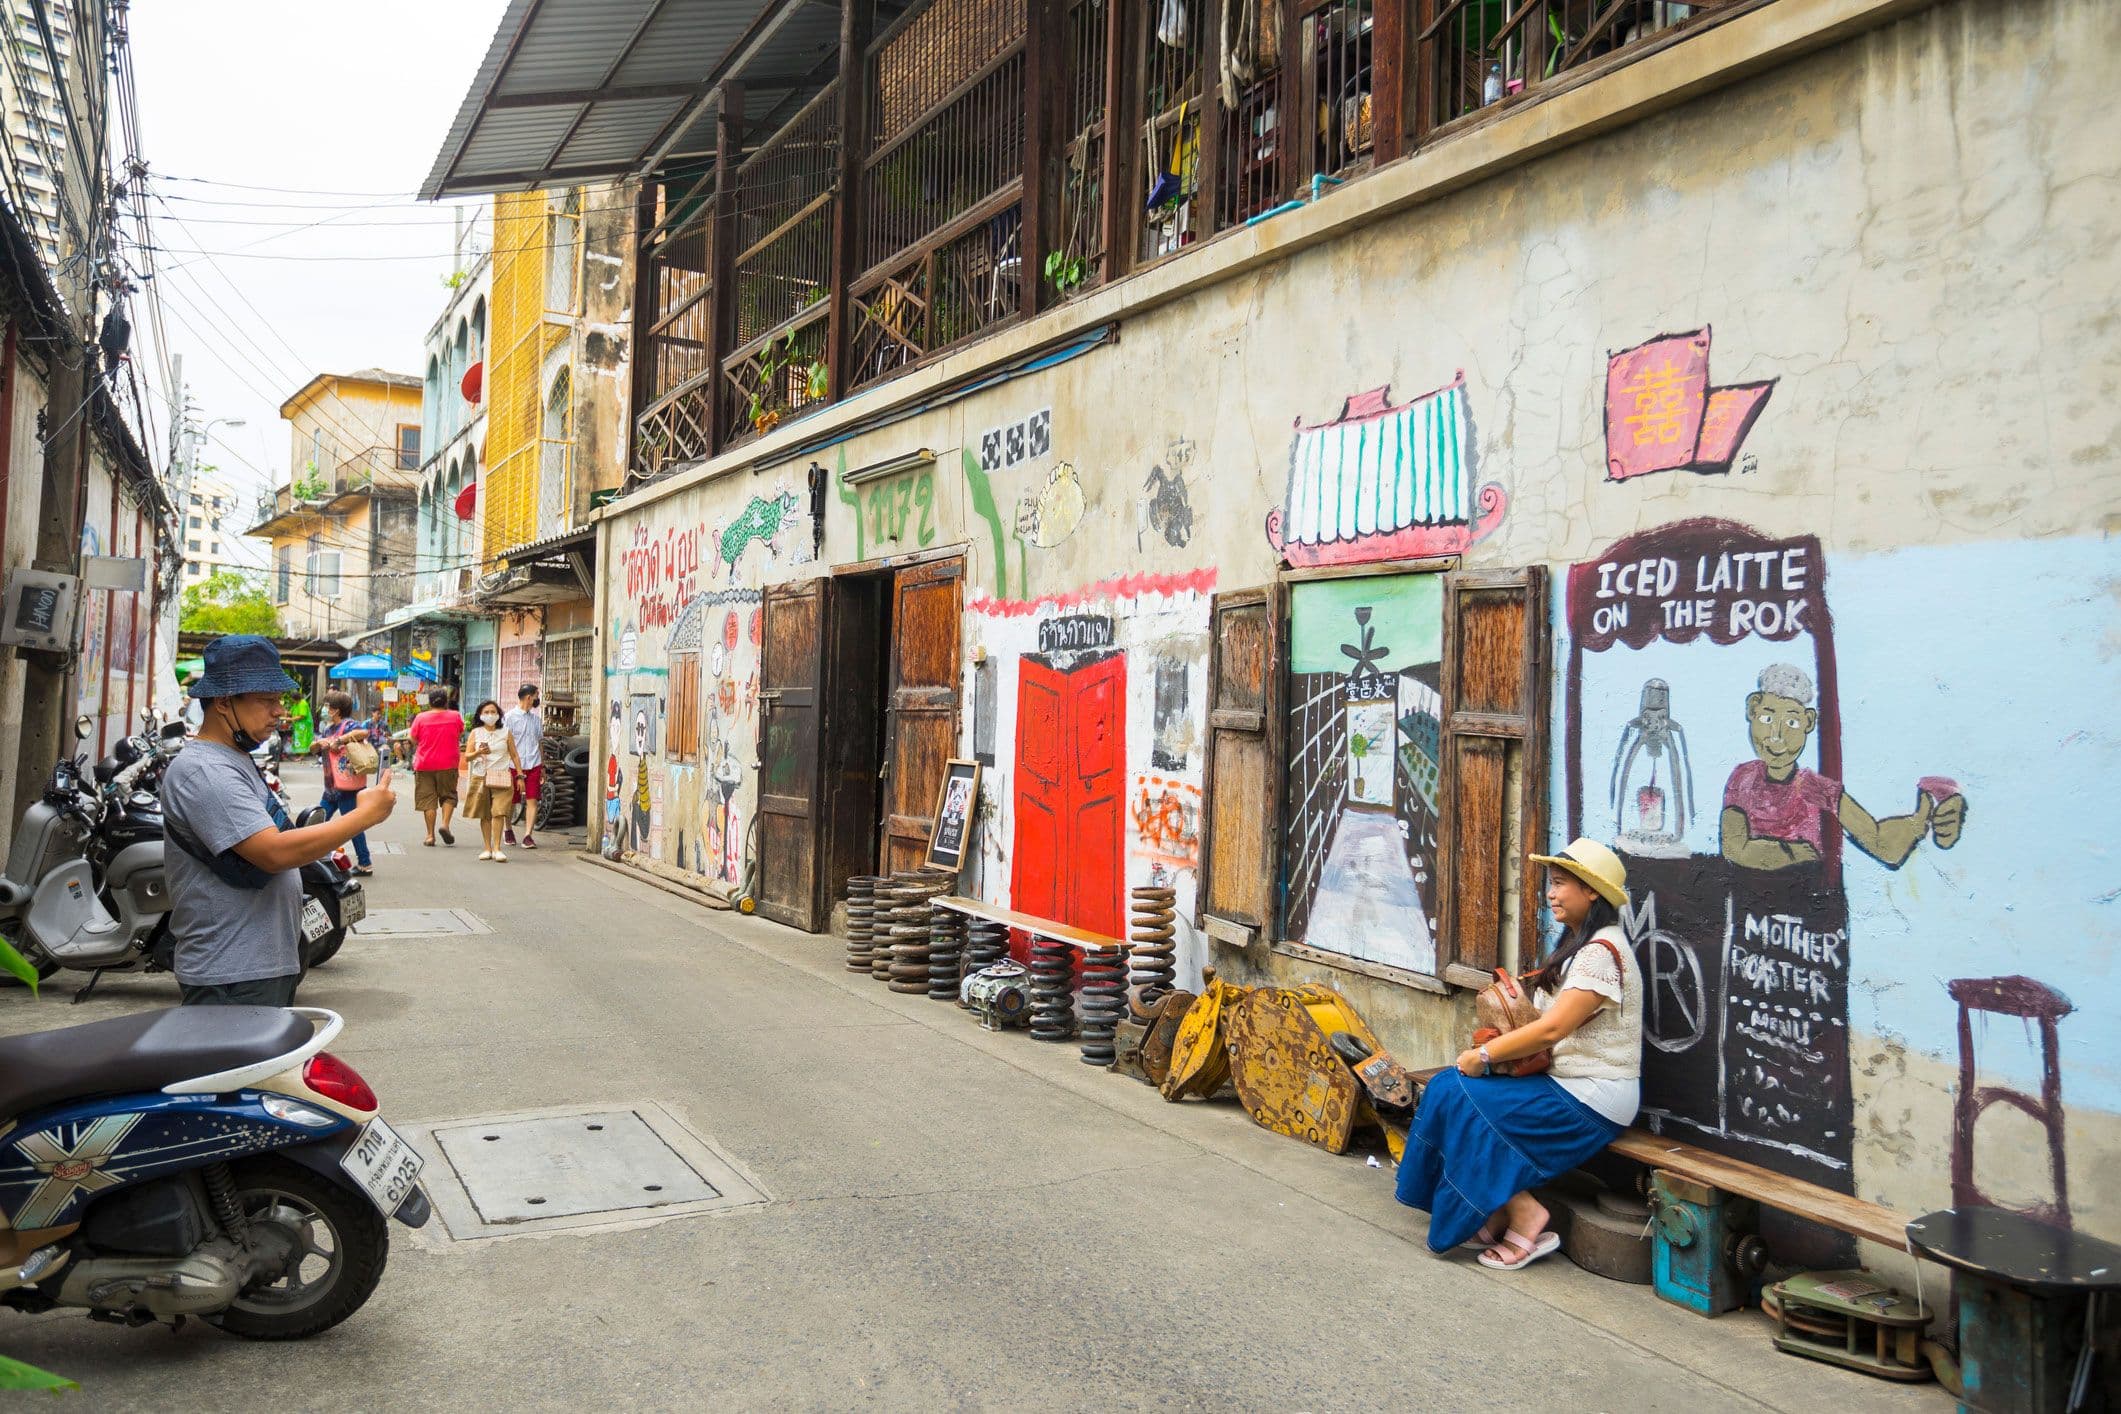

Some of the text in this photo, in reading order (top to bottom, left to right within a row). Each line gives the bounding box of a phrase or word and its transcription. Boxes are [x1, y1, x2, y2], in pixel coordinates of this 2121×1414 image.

[1596, 548, 1807, 598] ICED LATTE
[1040, 616, 1112, 652] ร้านกาแฟ
[1593, 598, 1808, 637] ON THE ROK
[1751, 1010, 1810, 1046] MENU
[387, 1156, 416, 1203] 6025
